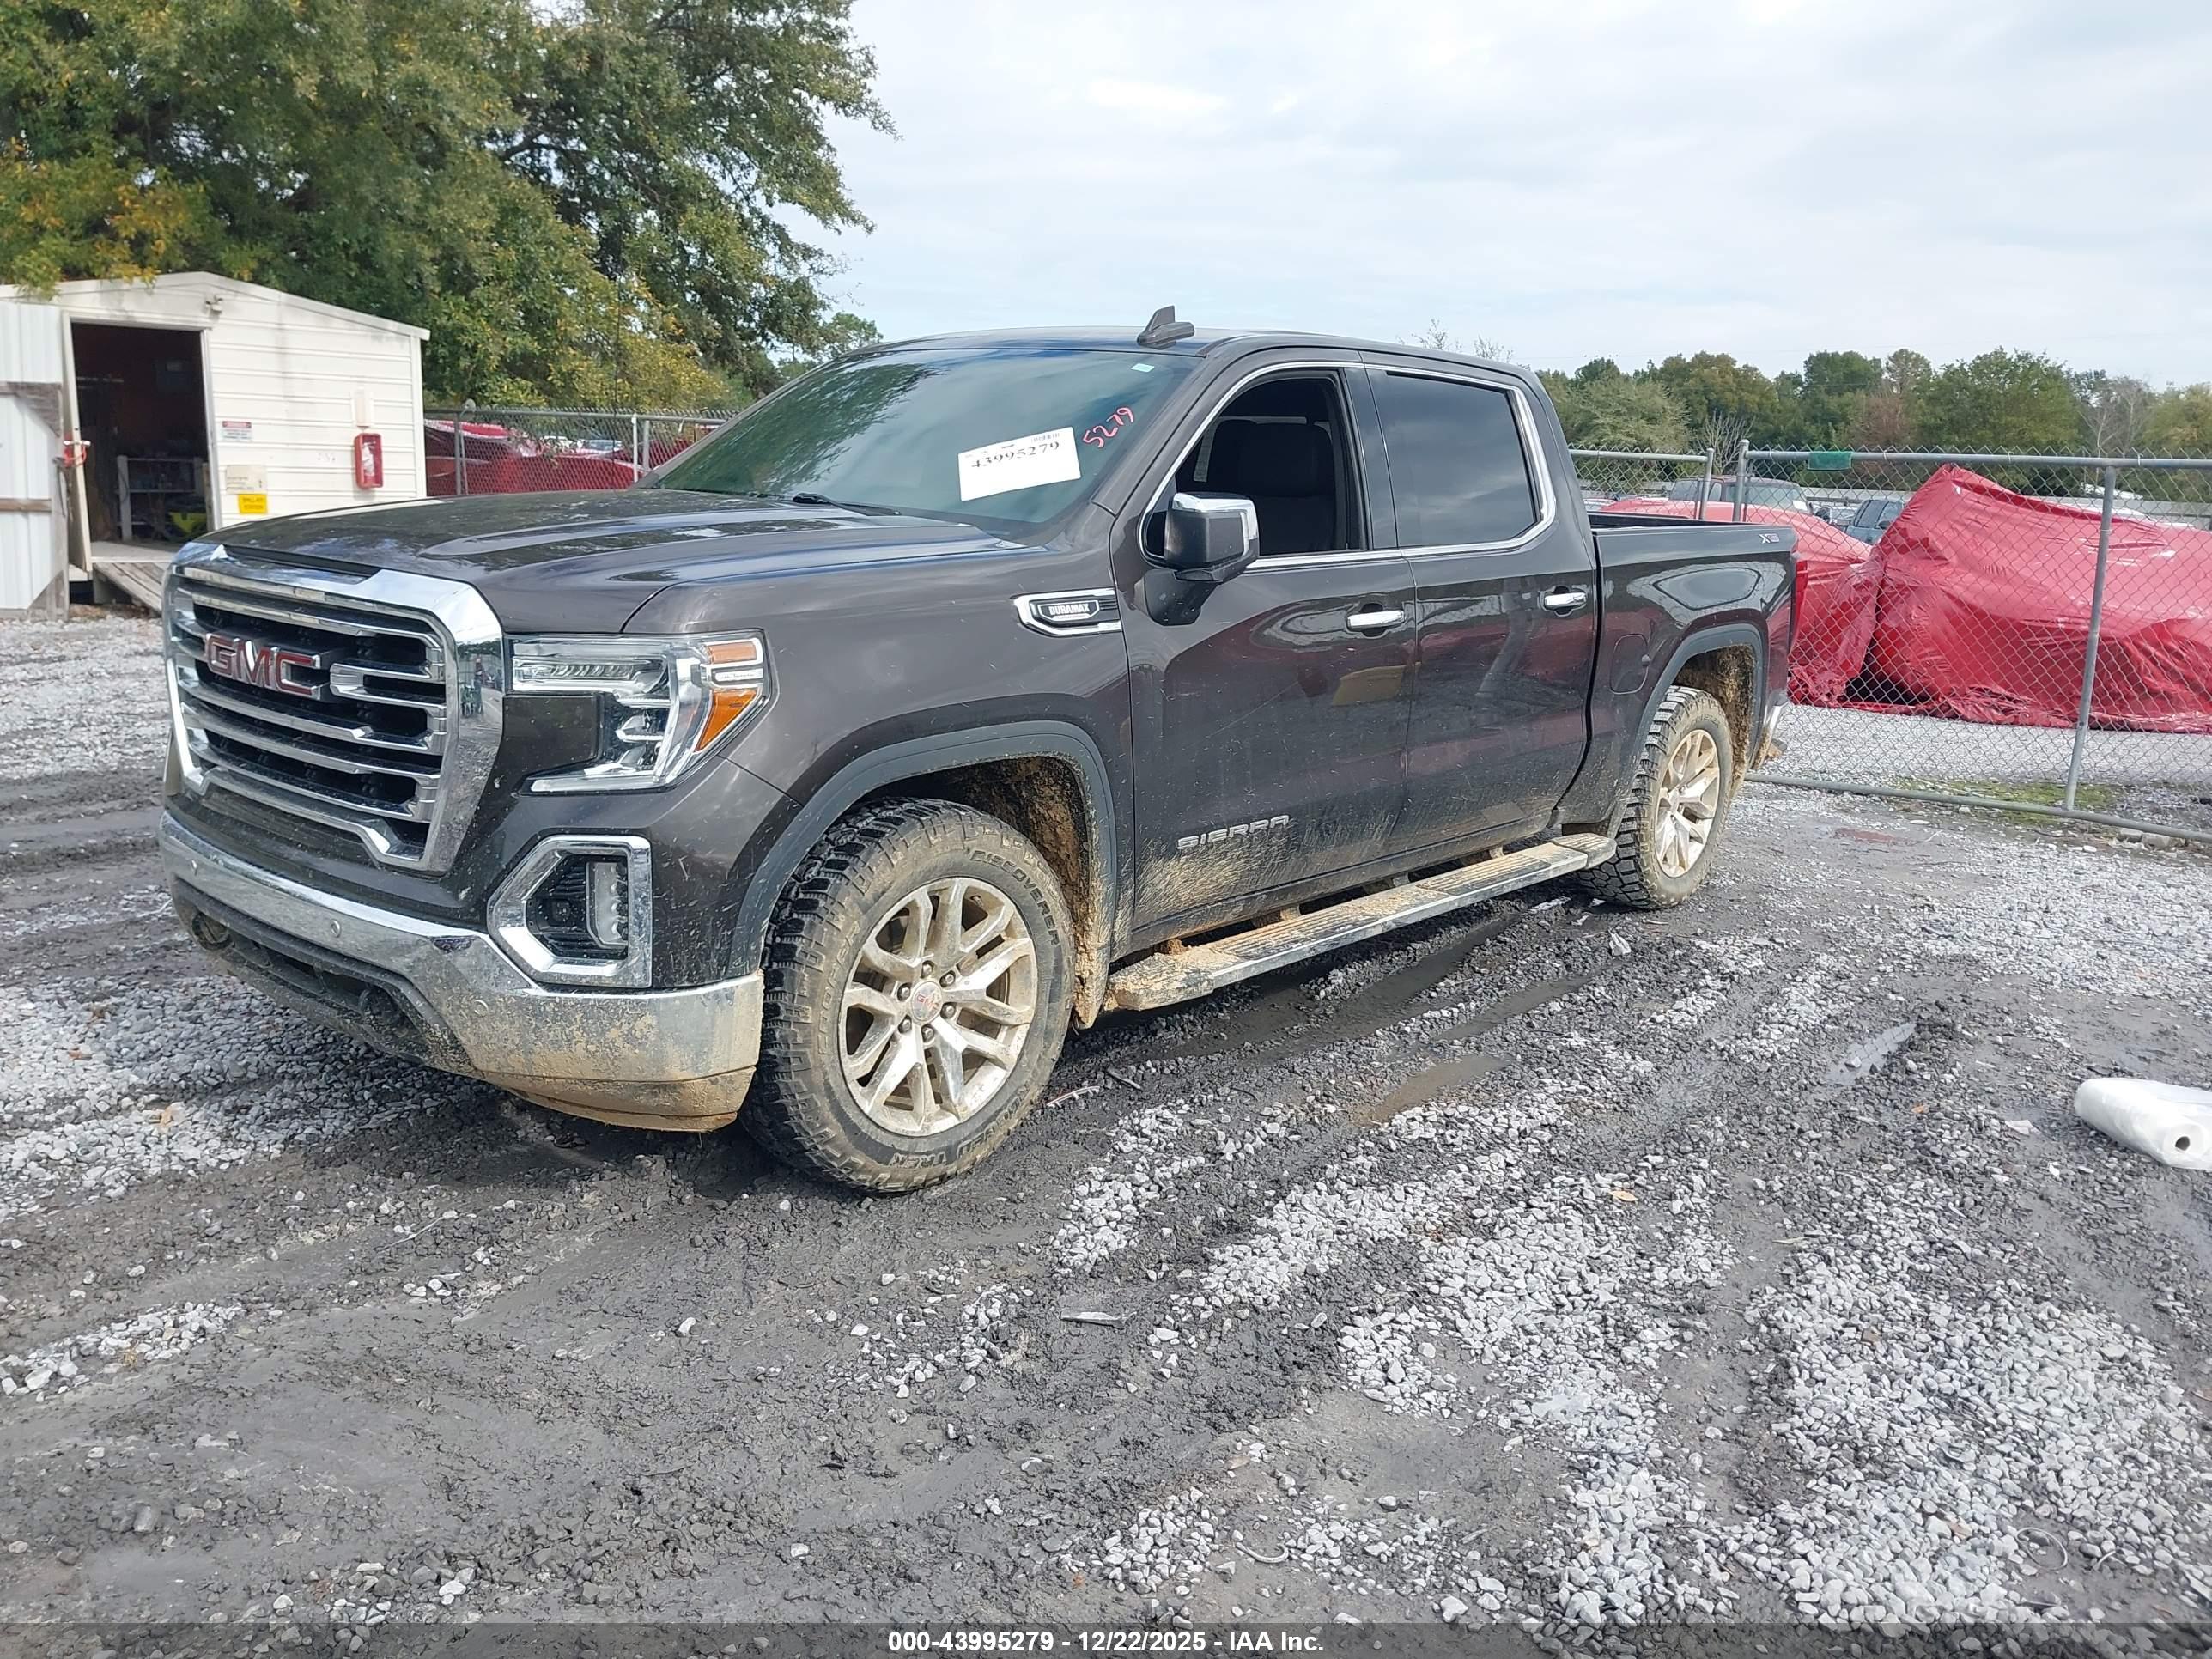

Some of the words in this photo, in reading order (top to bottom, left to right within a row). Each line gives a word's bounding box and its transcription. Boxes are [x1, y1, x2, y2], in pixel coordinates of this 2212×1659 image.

[1082, 406, 1134, 448] 5279
[971, 441, 1060, 468] 43995279
[1048, 604, 1091, 615] DURAMAX
[204, 633, 321, 701] GMC
[1177, 814, 1291, 850] SIERRA
[969, 849, 1060, 947] DISCOVERER
[889, 1151, 947, 1169] TREK
